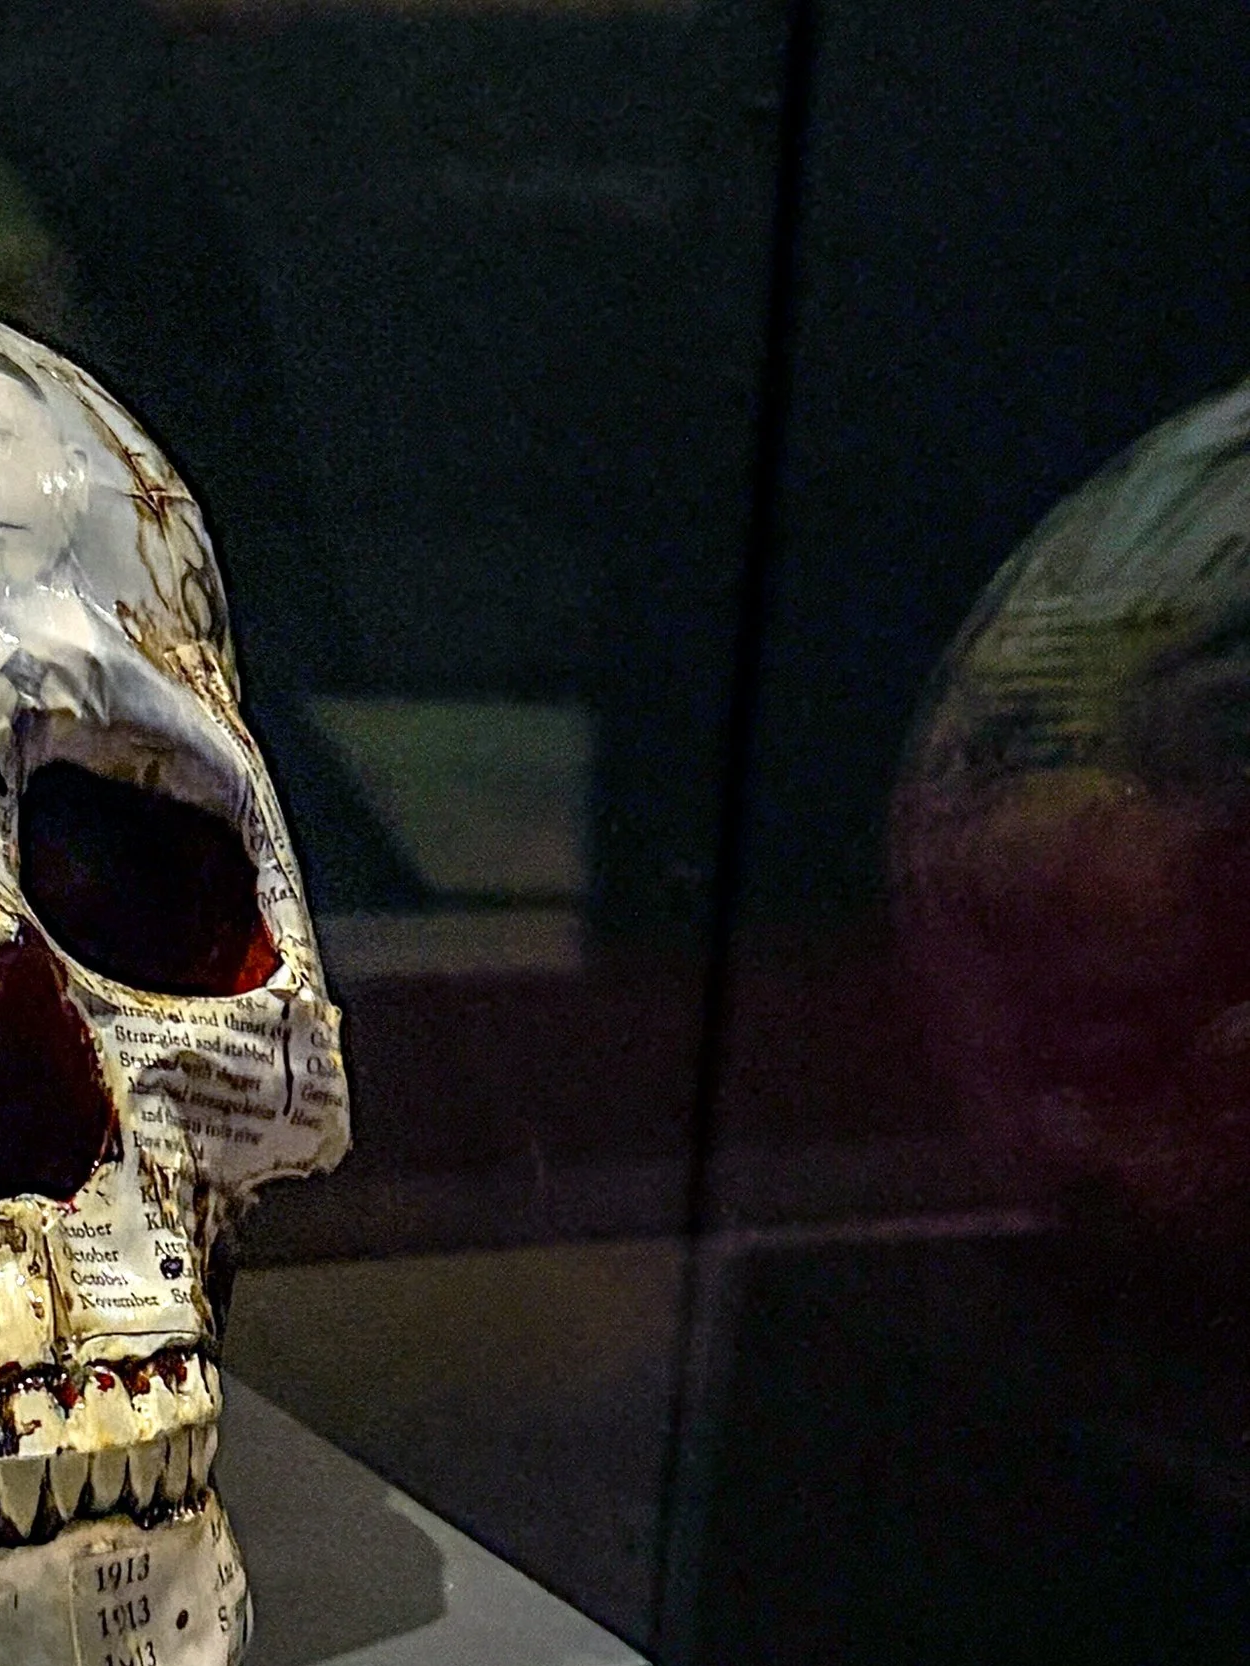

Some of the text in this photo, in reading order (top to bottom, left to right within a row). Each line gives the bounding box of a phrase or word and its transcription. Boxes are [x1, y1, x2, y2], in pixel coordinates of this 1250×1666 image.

[78, 1292, 160, 1310] November
[95, 1553, 150, 1592] 1913
[98, 1595, 150, 1637] 1913
